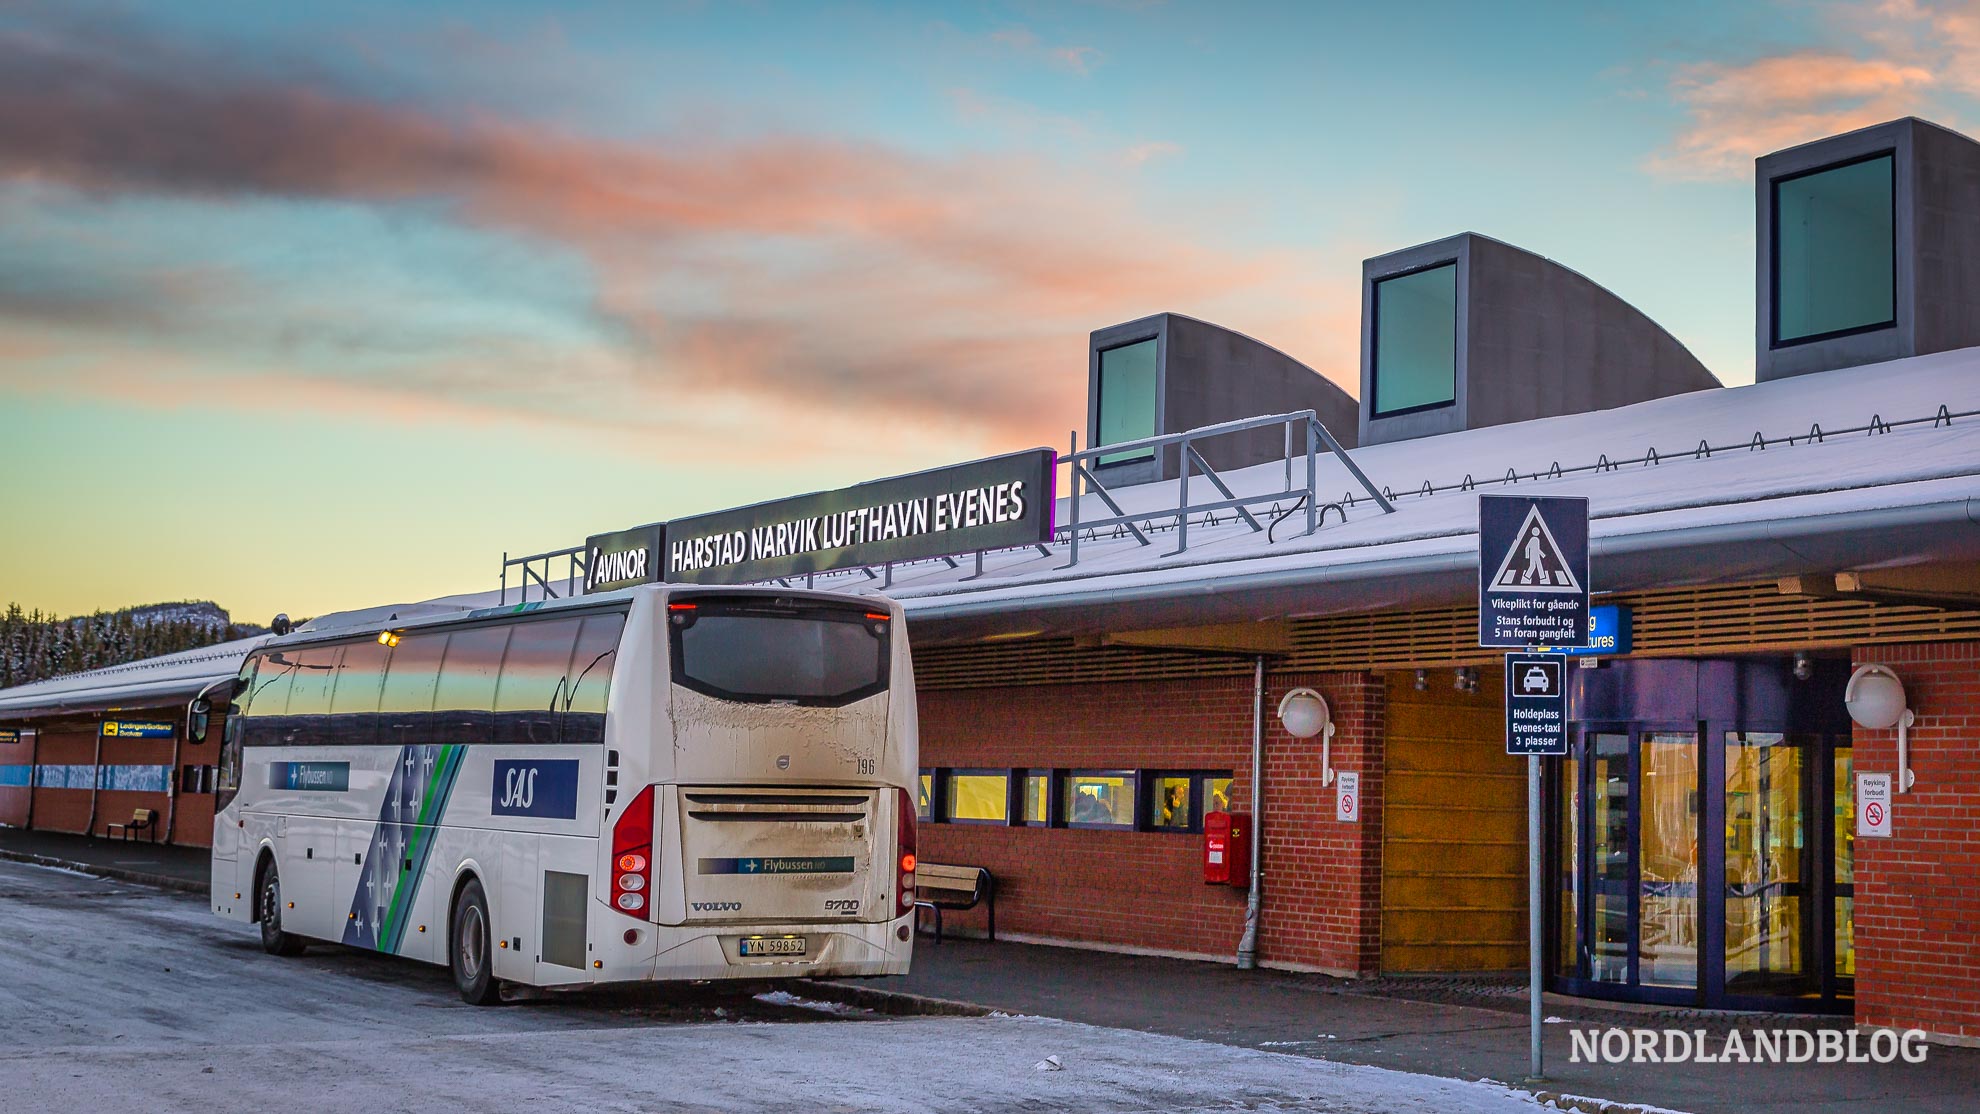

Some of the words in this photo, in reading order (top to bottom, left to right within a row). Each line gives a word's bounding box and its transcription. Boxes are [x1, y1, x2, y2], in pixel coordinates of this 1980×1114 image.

[595, 548, 646, 584] AVINOR
[671, 531, 746, 572] HARSTAD
[751, 516, 818, 560] NARVIK
[823, 497, 928, 548] LUFTHAVN
[935, 480, 1023, 532] EVENES
[1491, 599, 1530, 611] Vikeplikt
[1532, 599, 1546, 609] for
[1496, 615, 1521, 626] Stans
[1523, 615, 1555, 626] forbudt
[1557, 616, 1561, 626] i
[1563, 618, 1574, 629] og
[1495, 628, 1501, 637] 5
[1503, 629, 1512, 638] m
[1514, 628, 1537, 638] foran
[1539, 628, 1575, 640] gangfelt
[1513, 709, 1559, 721] Holdeplass
[1512, 723, 1561, 733] Evenes-taxi
[1515, 736, 1521, 746] 3
[1525, 736, 1558, 748] plasser
[856, 758, 875, 775] 196
[500, 767, 538, 808] SAS
[1863, 779, 1886, 788] Røyking
[764, 859, 813, 872] Flybussen
[690, 902, 742, 911] VOLVO
[824, 900, 860, 910] 9700
[749, 941, 764, 951] YN
[769, 940, 804, 951] 59852
